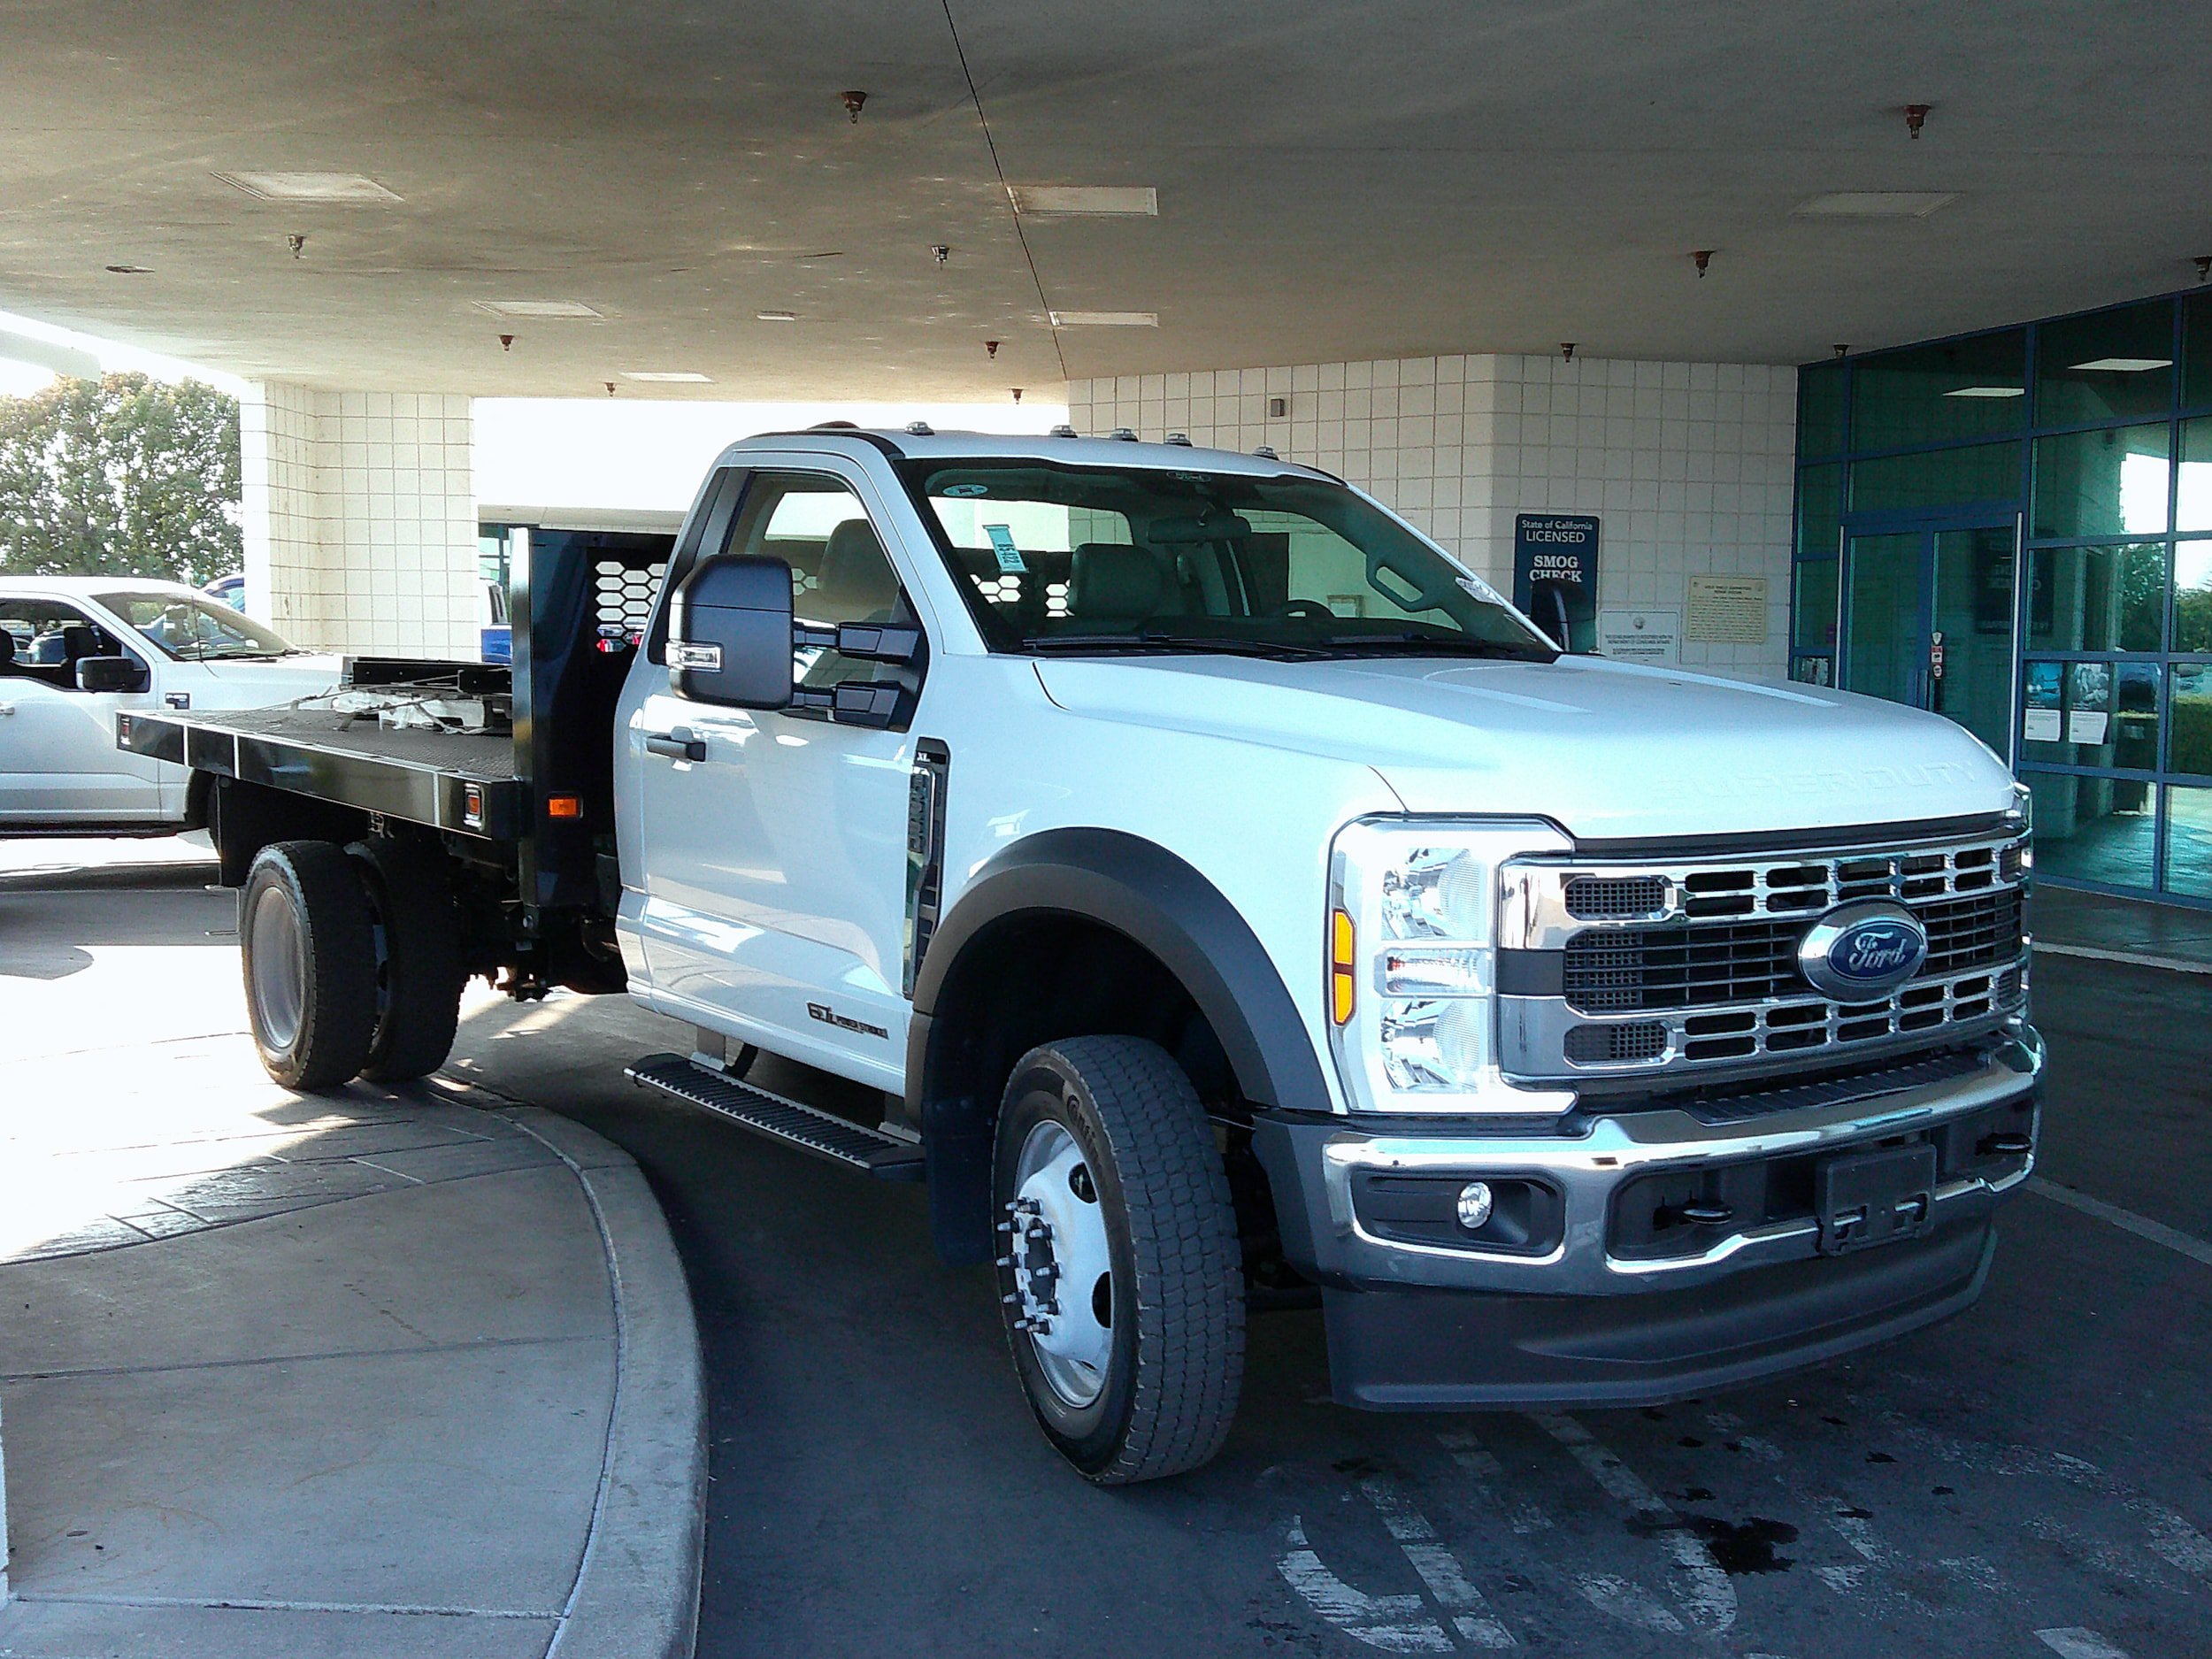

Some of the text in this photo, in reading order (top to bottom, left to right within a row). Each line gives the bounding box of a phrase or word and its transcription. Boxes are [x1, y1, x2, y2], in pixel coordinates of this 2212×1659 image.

[1521, 519, 1594, 531] State of California
[1525, 530, 1586, 543] LICENSED
[1533, 555, 1578, 569] SMOG
[1529, 569, 1582, 582] CHECK
[1862, 760, 1976, 791] DUTY
[1849, 932, 1908, 972] Ford
